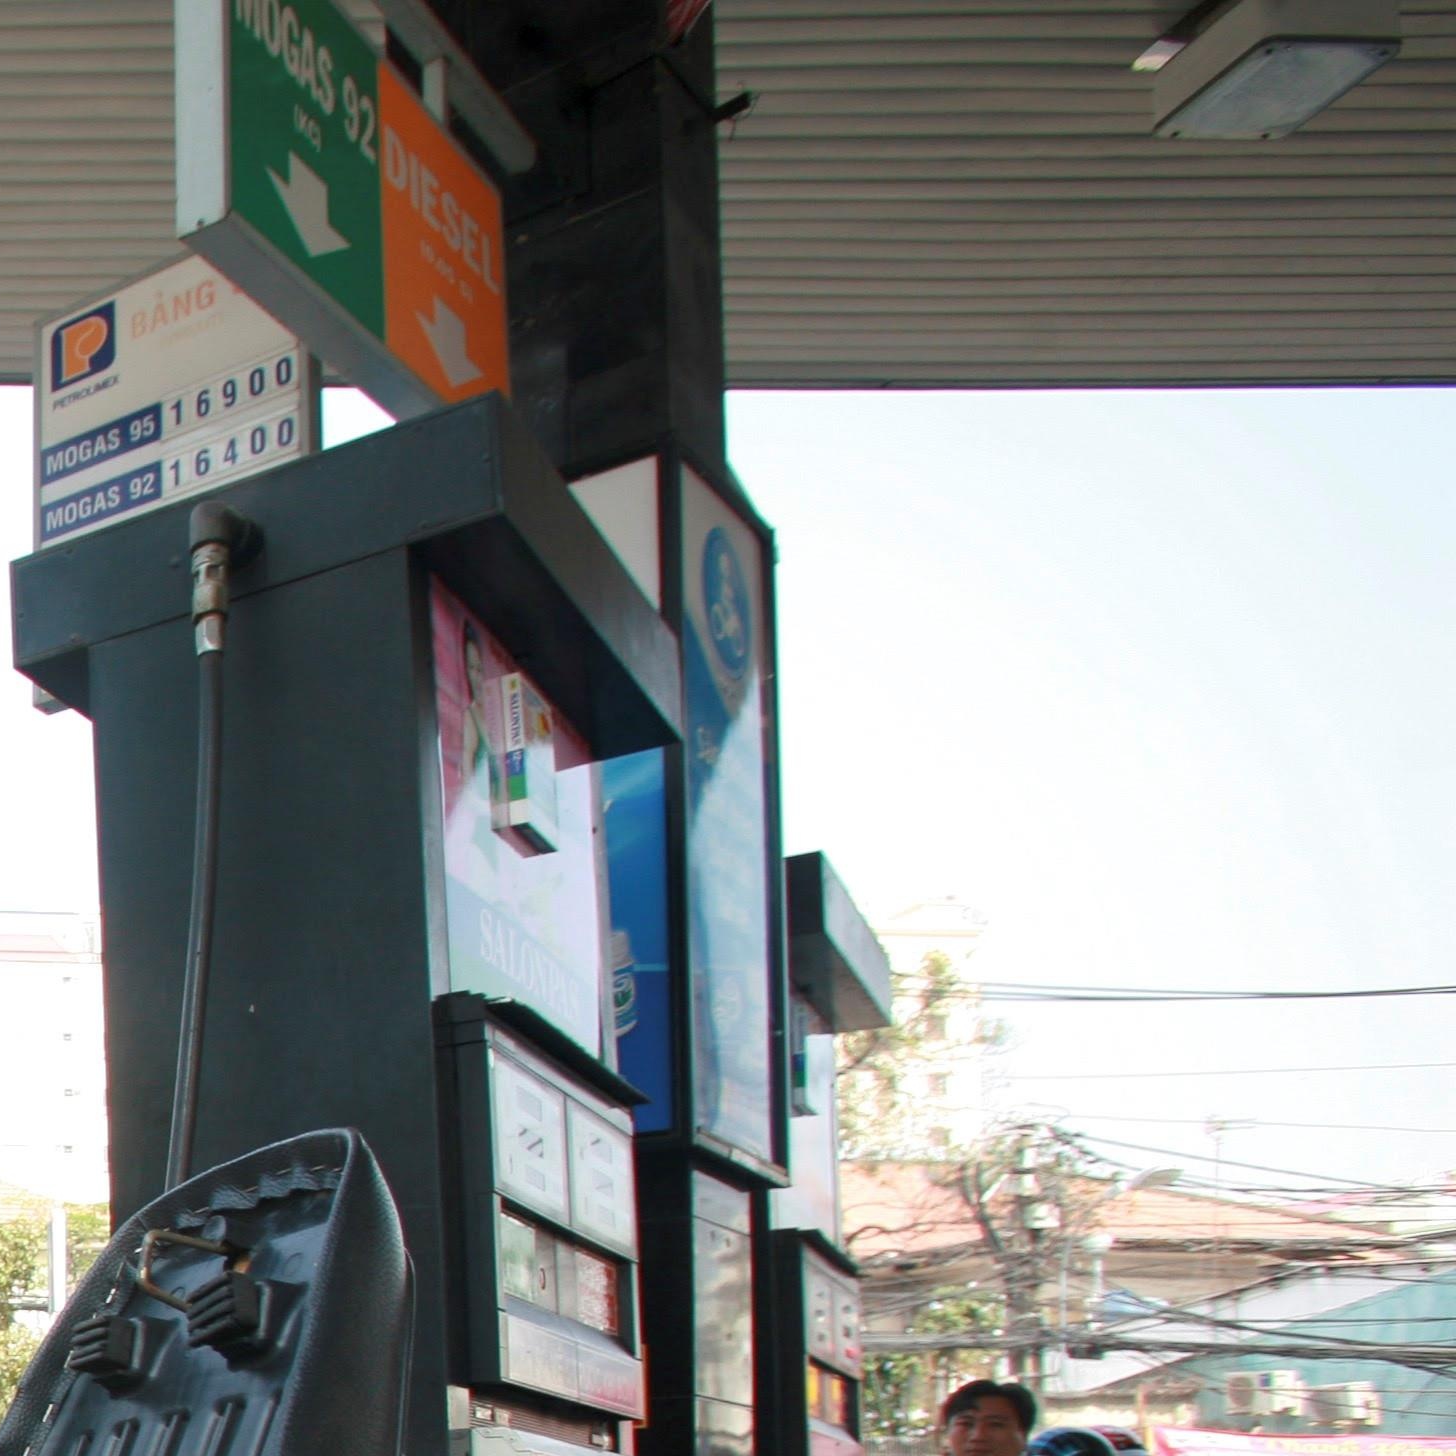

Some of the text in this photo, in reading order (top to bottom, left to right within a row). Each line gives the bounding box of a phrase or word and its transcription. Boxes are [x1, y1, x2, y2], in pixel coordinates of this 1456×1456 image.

[235, 0, 377, 165] MOGAS 92
[385, 125, 501, 297] DIESEL
[130, 280, 217, 340] BẢNG
[45, 355, 293, 477] MOGAS 95 16900
[52, 374, 120, 412] PETROLIMEX
[45, 416, 295, 533] MOGAS 92 16400
